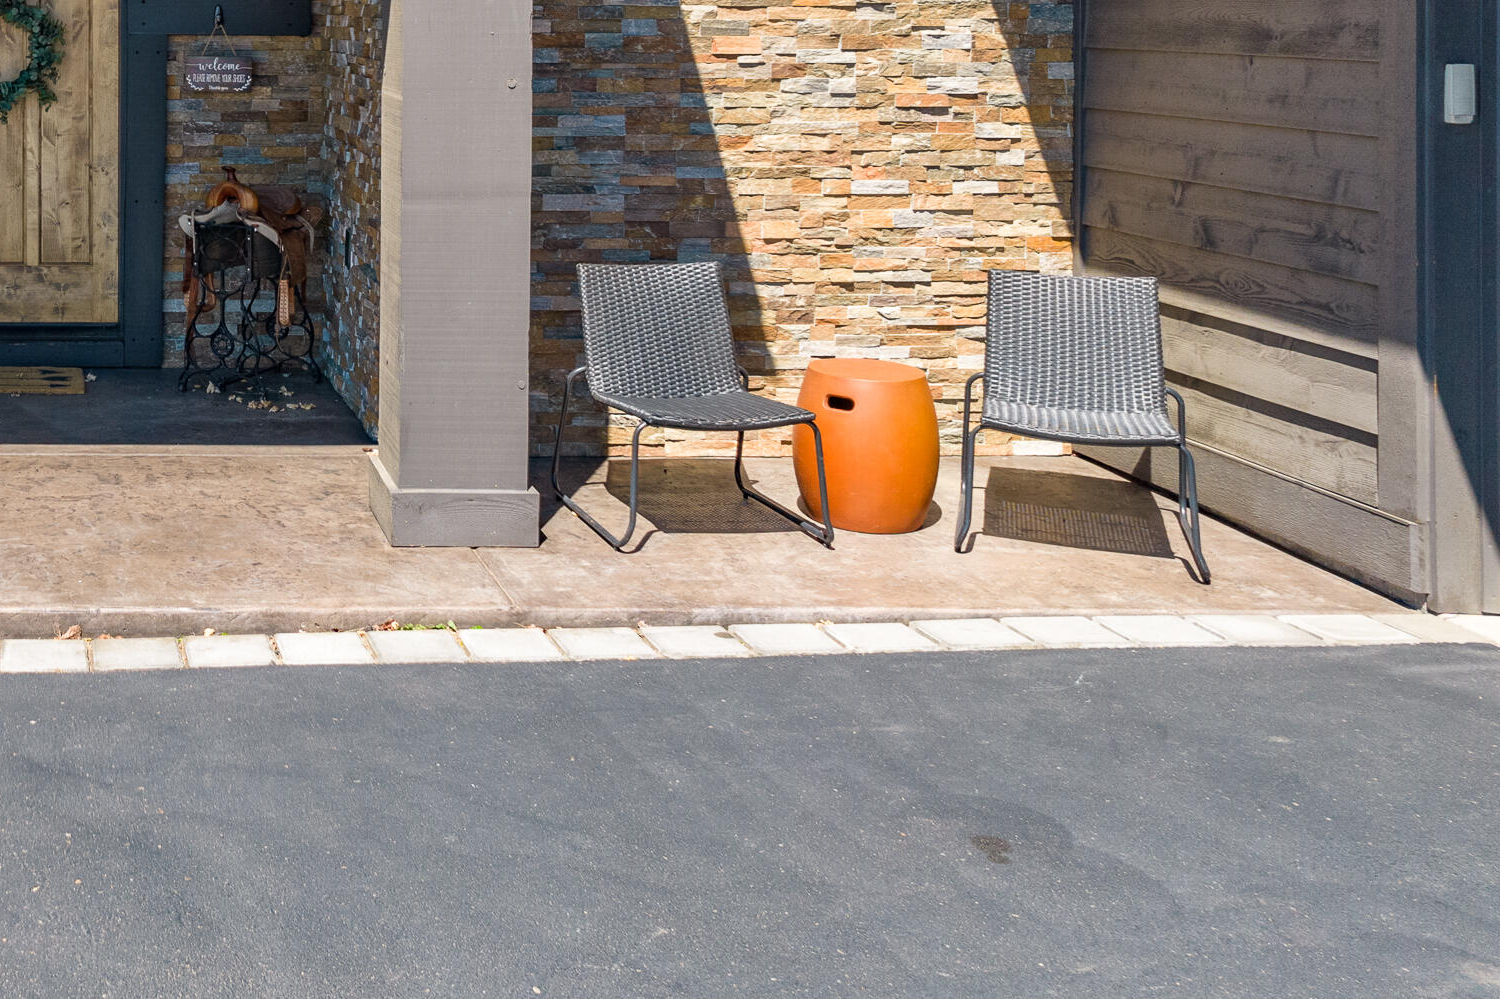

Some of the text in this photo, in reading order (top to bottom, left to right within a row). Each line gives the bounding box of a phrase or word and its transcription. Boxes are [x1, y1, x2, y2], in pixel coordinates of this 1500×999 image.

[197, 56, 243, 71] welcome
[192, 73, 246, 83] PLEASE REMOVE YOUR SHOES
